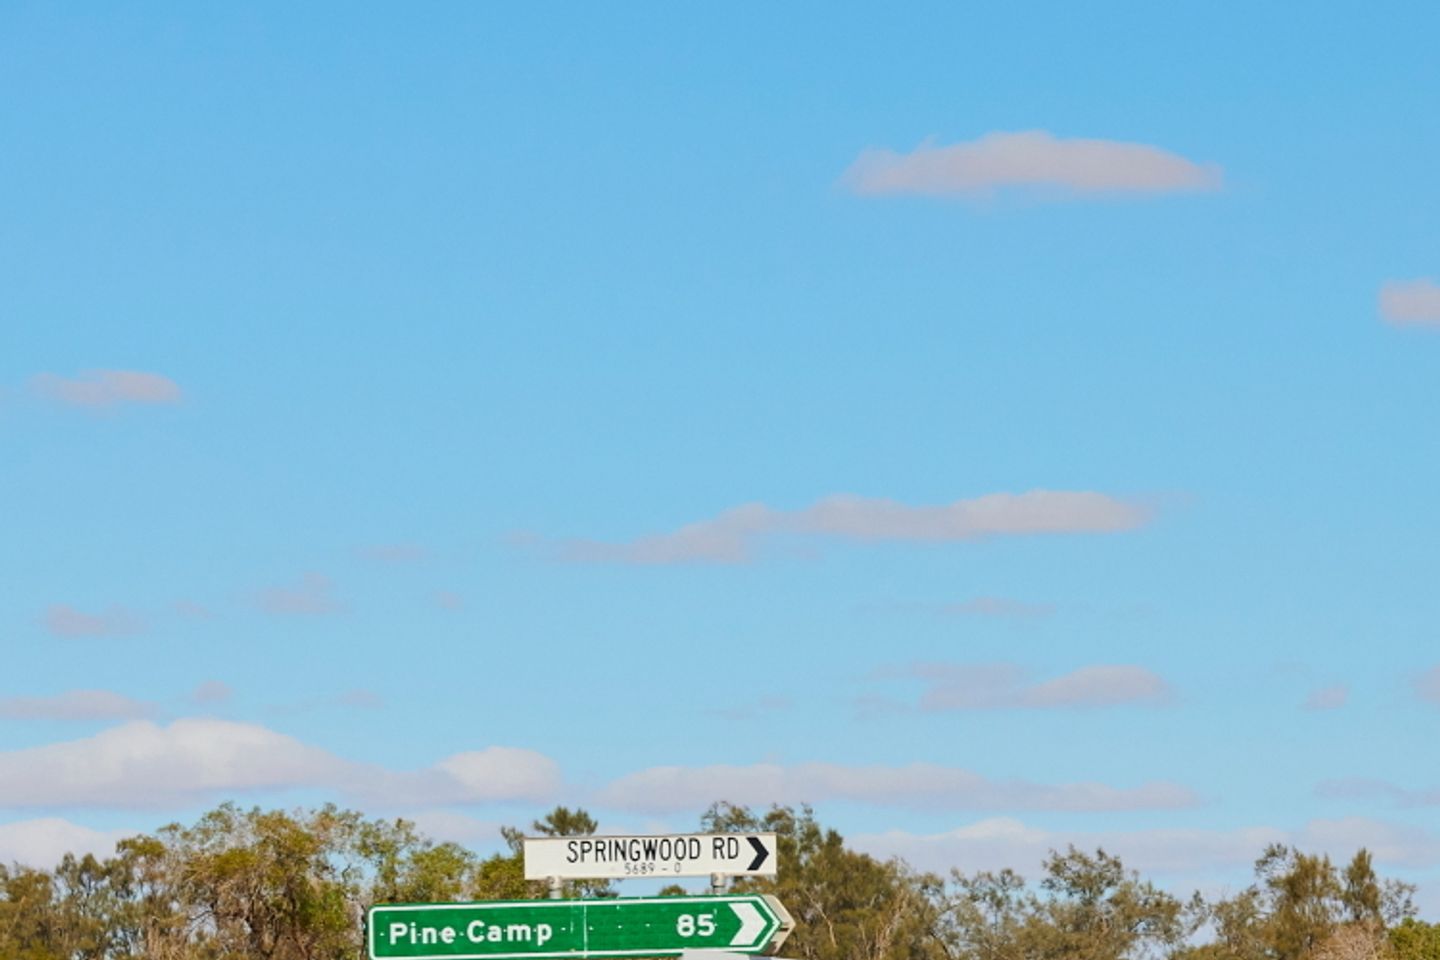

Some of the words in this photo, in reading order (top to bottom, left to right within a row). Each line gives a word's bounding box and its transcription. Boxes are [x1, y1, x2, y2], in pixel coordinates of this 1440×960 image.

[566, 837, 701, 863] SPRINGWOOD
[712, 835, 739, 860] RD
[389, 922, 456, 945] Pine
[466, 919, 552, 946] Camp
[676, 913, 716, 937] 85
